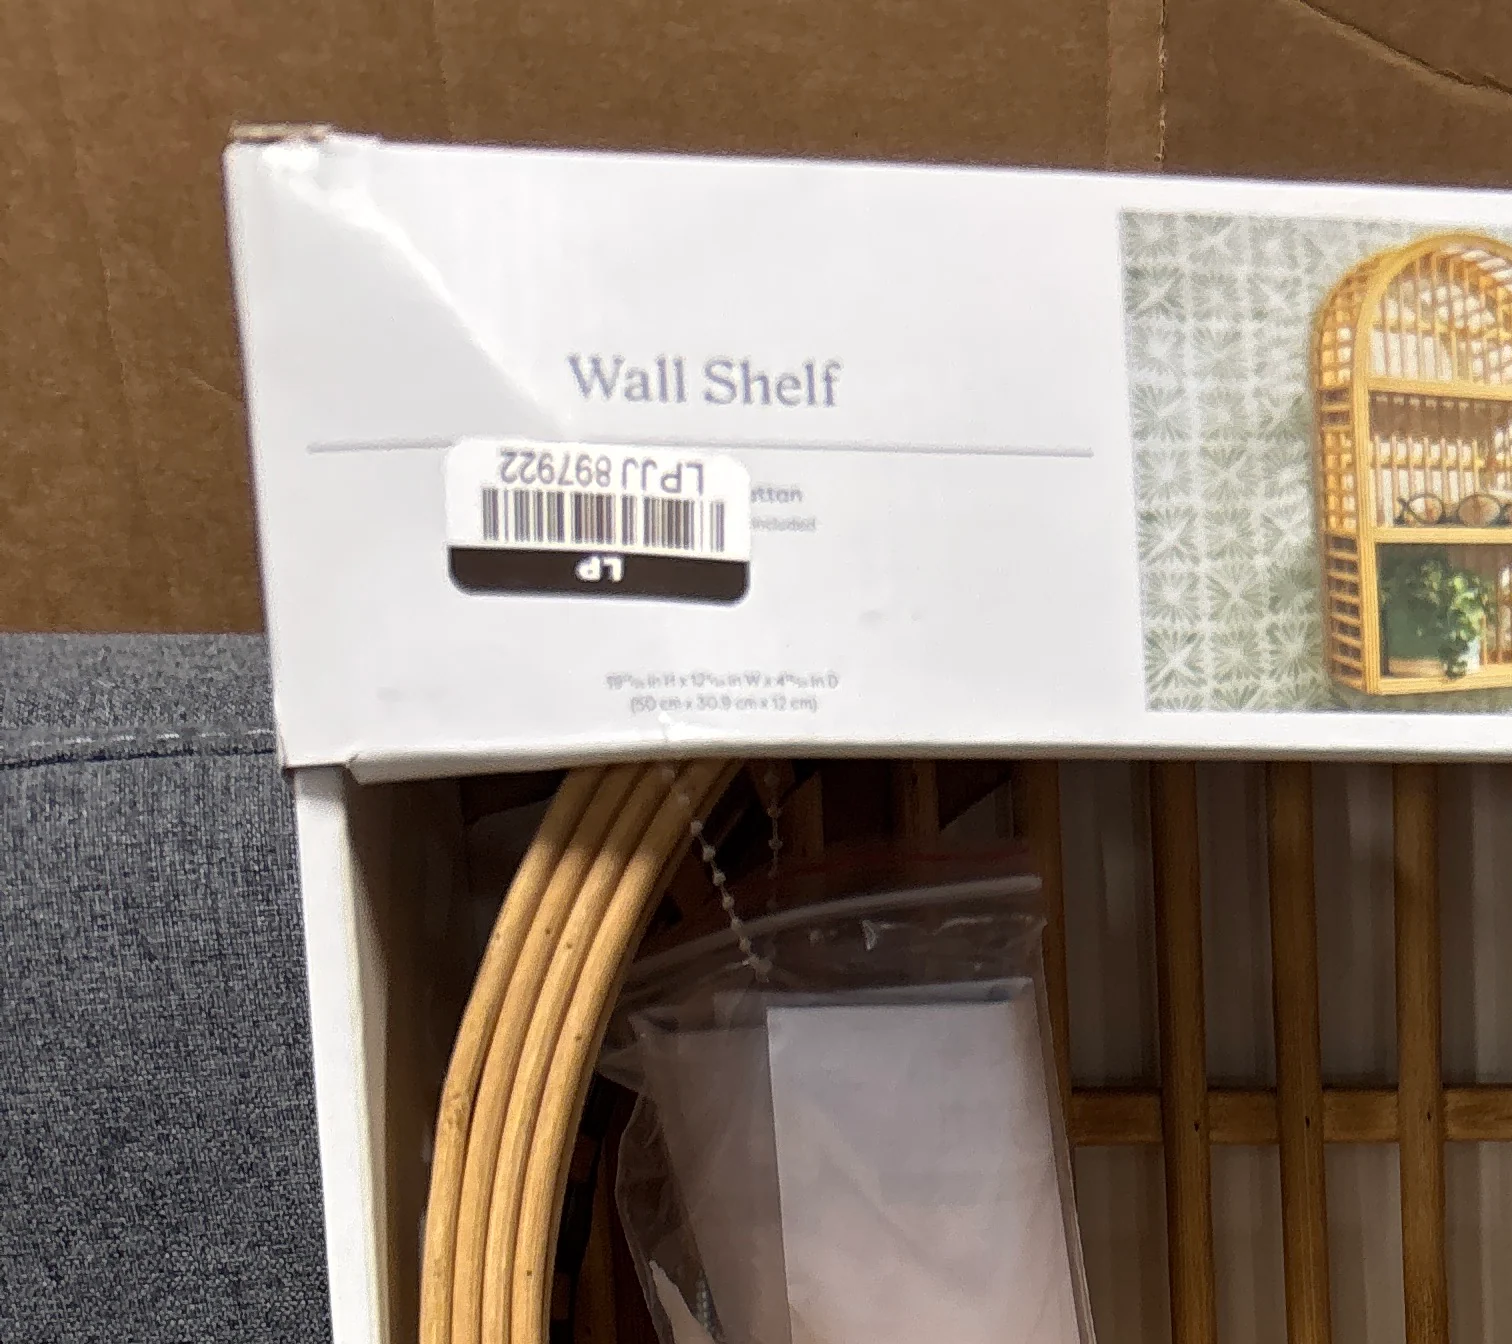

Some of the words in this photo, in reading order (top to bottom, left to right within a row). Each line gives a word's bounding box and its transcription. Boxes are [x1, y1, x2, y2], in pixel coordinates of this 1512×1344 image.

[567, 353, 688, 403] Wall
[702, 354, 843, 407] Shelf
[500, 449, 611, 488] 897922
[622, 457, 704, 495] LPJJ
[574, 555, 625, 583] LP
